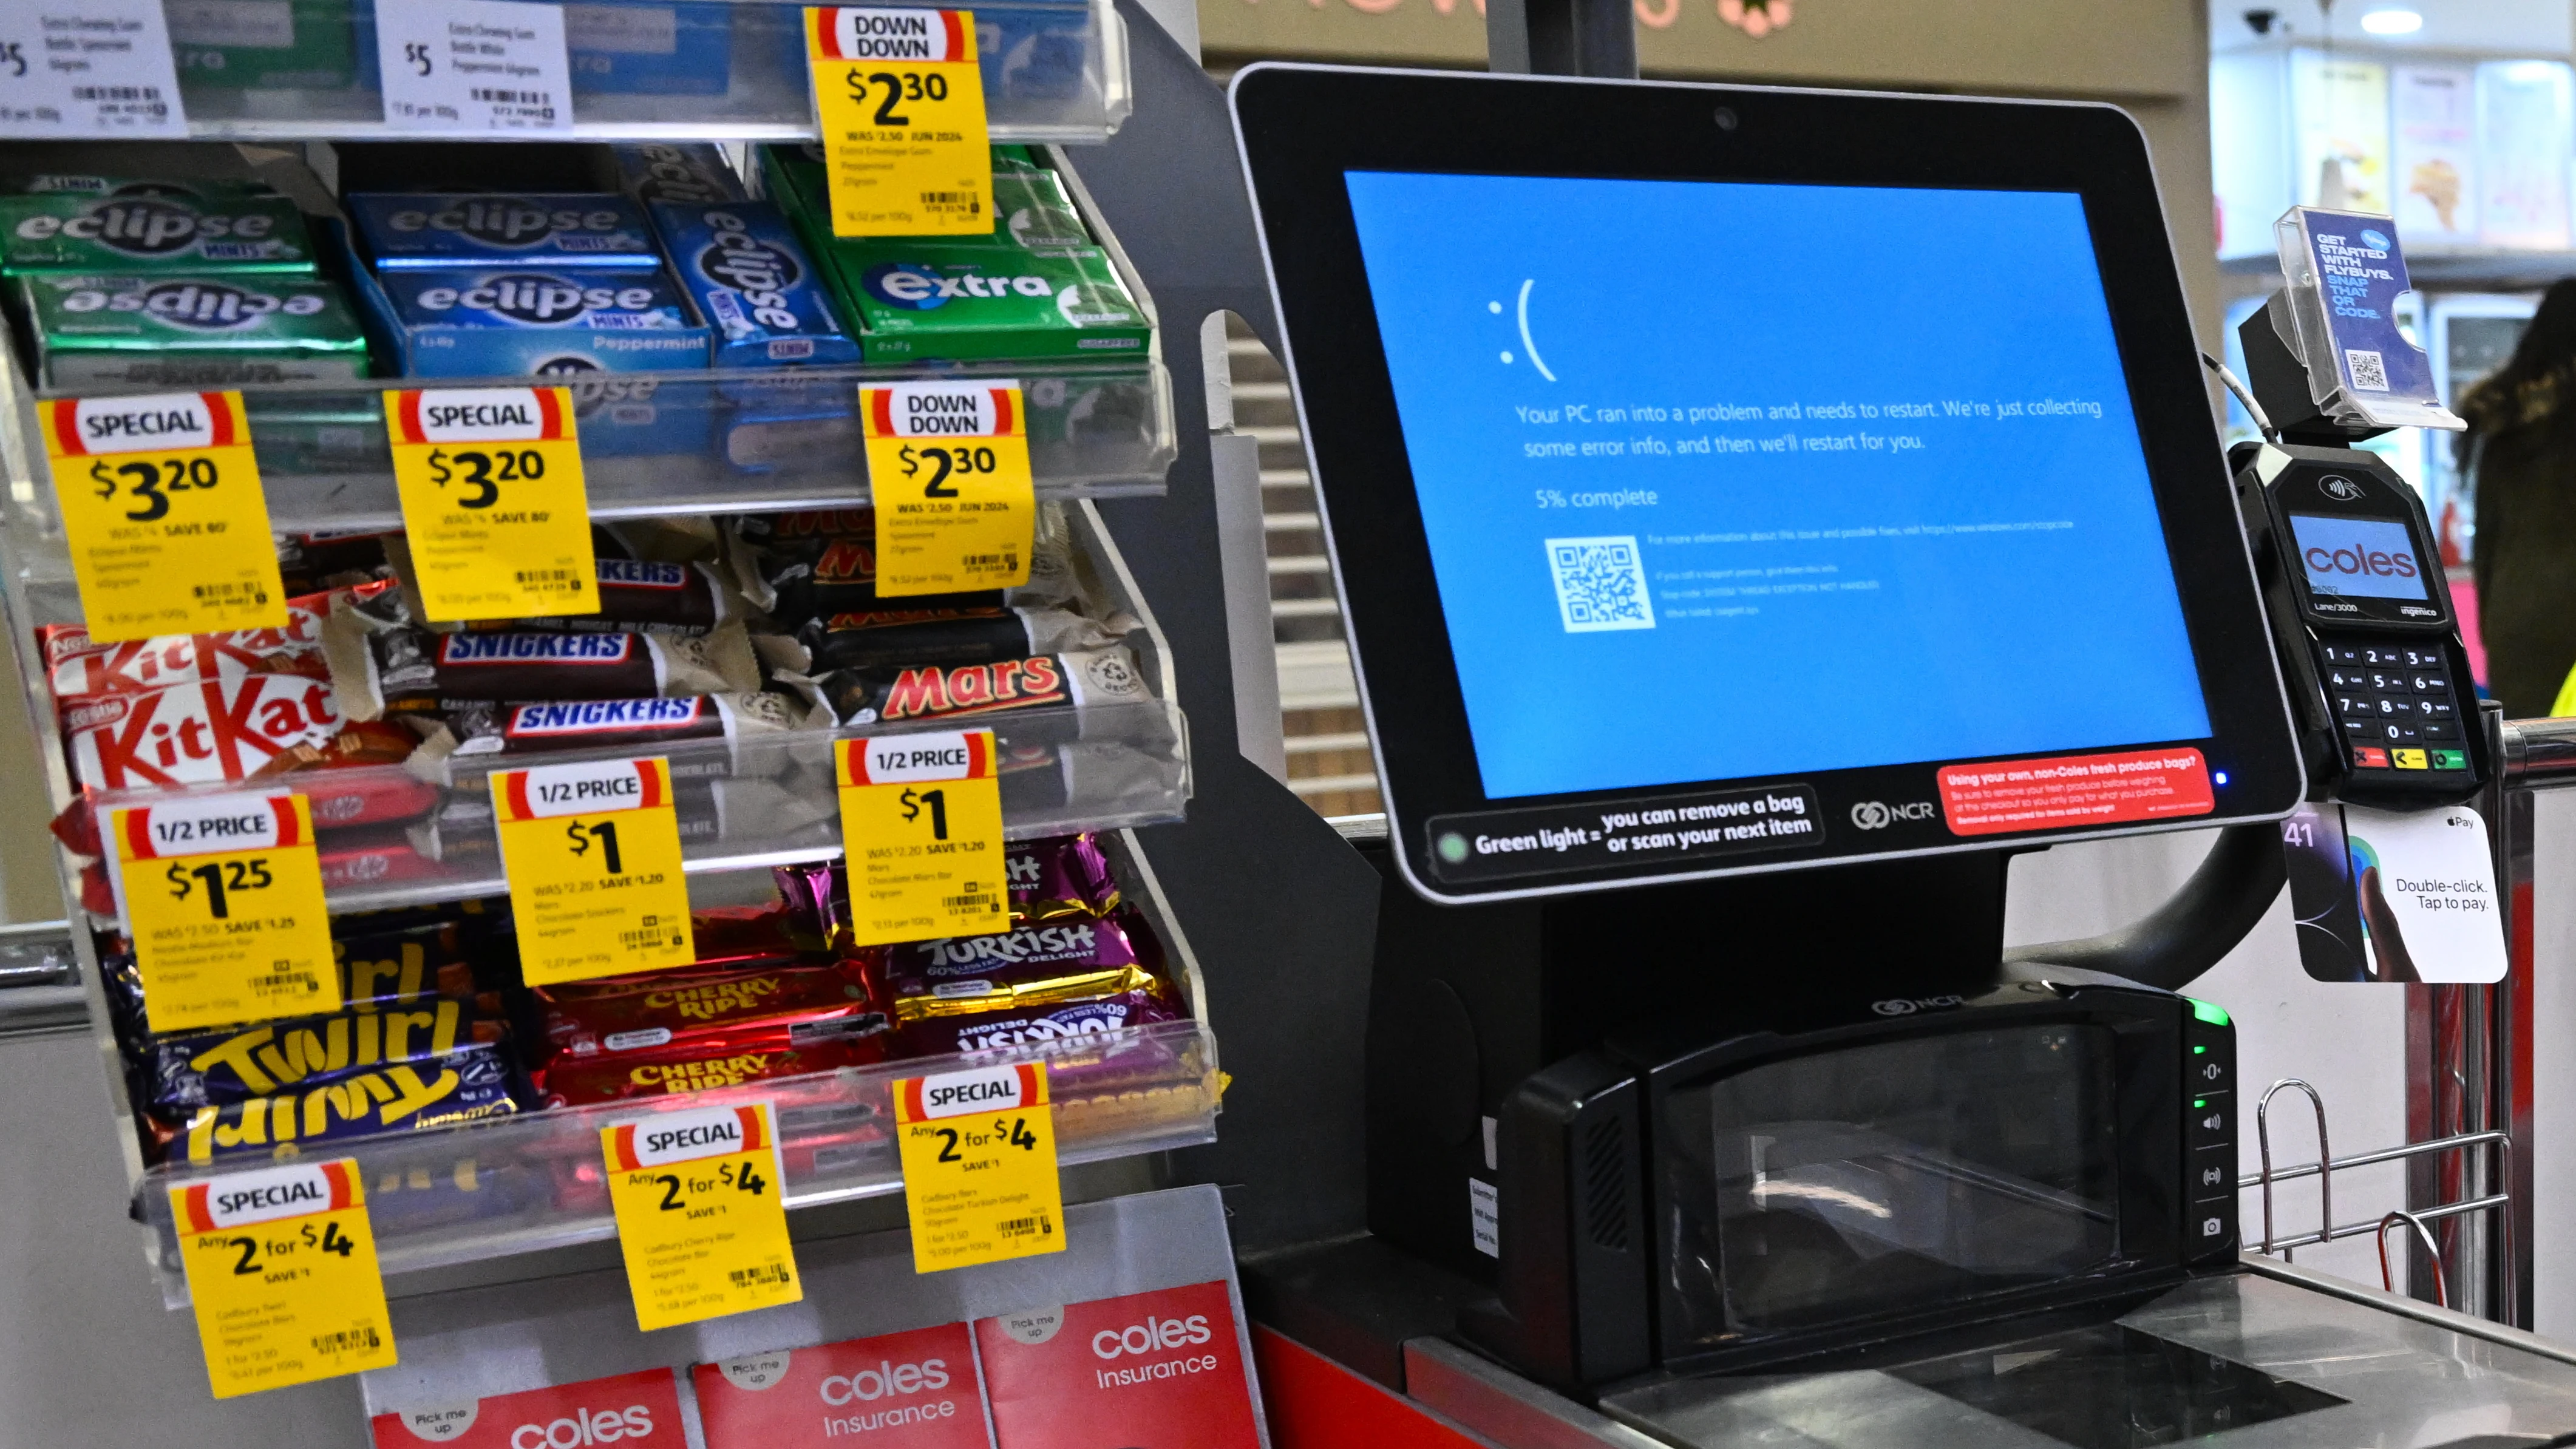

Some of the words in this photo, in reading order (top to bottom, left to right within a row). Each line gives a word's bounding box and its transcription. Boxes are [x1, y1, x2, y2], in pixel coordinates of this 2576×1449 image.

[854, 16, 927, 35] DOWN
[857, 38, 929, 58] DOWN
[405, 42, 432, 76] $5
[16, 208, 274, 248] eclipse
[389, 199, 620, 240] eclipse
[2317, 233, 2347, 245] GET
[2319, 244, 2388, 260] STARTED
[2323, 255, 2362, 267] WITH
[2325, 264, 2394, 280] FLYBUYS.
[2327, 275, 2369, 288] SNAP
[880, 271, 1053, 301] extra
[2330, 285, 2369, 299] THAT
[417, 280, 654, 319] eclipse
[2333, 295, 2356, 307] OR
[2334, 306, 2381, 319] CODE.
[593, 335, 705, 352] Peppermint
[908, 395, 977, 413] DOWN
[1515, 406, 1559, 424] Your
[1565, 404, 1592, 423] PC
[1597, 406, 1628, 422] ran
[1631, 405, 1667, 422] into
[1673, 407, 1684, 422] a
[1689, 403, 1763, 425] problem
[1768, 402, 1801, 420] and
[1806, 401, 1857, 419] needs
[1860, 402, 1879, 418] to
[1883, 401, 1939, 418] restart.
[1942, 399, 1991, 417] We're
[1996, 399, 2023, 421] just
[2027, 398, 2102, 418] collecting
[86, 407, 203, 439] SPECIAL
[427, 404, 534, 427] SPECIAL
[909, 415, 980, 434] DOWN
[1524, 441, 1577, 458] some
[1582, 441, 1625, 457] error
[1630, 435, 1672, 458] info,
[1676, 435, 1711, 454] and
[1715, 435, 1756, 453] then
[1759, 434, 1798, 452] we'll
[1803, 433, 1857, 452] restart
[1860, 432, 1885, 450] for
[1888, 435, 1926, 453] you.
[1535, 489, 1568, 509] 5%
[1571, 488, 1659, 511] complete
[492, 512, 527, 525] SAVE
[165, 523, 202, 537] SAVE
[2305, 543, 2416, 578] coles
[2314, 603, 2358, 613] Lane/3000
[2400, 606, 2438, 617] ingenico
[451, 631, 625, 659] SNICKERS
[2326, 647, 2335, 660] 1
[2366, 650, 2378, 663] 2
[2407, 652, 2419, 665] 3
[882, 656, 1060, 721] Mars
[2333, 673, 2343, 685] 4
[2374, 675, 2385, 688] 5
[2415, 677, 2426, 689] 6
[520, 697, 693, 728] SNICKERS
[2340, 698, 2350, 712] 7
[2381, 700, 2393, 713] 8
[2421, 701, 2432, 714] 9
[93, 675, 339, 791] KitKat
[2387, 725, 2399, 739] 0
[877, 752, 906, 771] 1/2
[911, 747, 968, 768] PRICE
[1948, 773, 1980, 787] Using
[1980, 773, 2006, 786] your
[2007, 770, 2034, 782] own,
[2034, 765, 2090, 780] non-Coles
[2090, 762, 2118, 776] fresh
[2119, 759, 2163, 774] produce
[2164, 755, 2197, 770] bags?
[538, 782, 573, 804] 1/2
[576, 776, 640, 799] PRICE
[900, 787, 948, 840] $1
[1602, 810, 1639, 835] you
[1642, 808, 1675, 827] can
[1679, 801, 1750, 823] remove
[1752, 801, 1766, 816] a
[1768, 793, 1804, 816] bag
[1892, 801, 1935, 821] NCR
[155, 821, 192, 843] 1/2
[199, 811, 270, 840] PRICE
[2455, 816, 2474, 830] Pay
[1475, 833, 1538, 855] Green
[1540, 827, 1587, 852] light
[1607, 835, 1628, 852] or
[1631, 830, 1676, 850] scan
[1677, 829, 1720, 850] your
[1724, 823, 1767, 842] next
[1768, 818, 1812, 838] item
[2284, 822, 2314, 848] 41
[567, 820, 623, 874] $1
[926, 842, 957, 855] SAVE
[599, 875, 633, 889] SAVE
[2396, 878, 2488, 894] Double-click.
[2416, 895, 2442, 911] Tap
[2445, 896, 2459, 909] to
[2462, 897, 2490, 911] pay.
[225, 918, 262, 934] SAVE
[917, 924, 1096, 966] TURKISH
[1027, 950, 1096, 964] DELIGHT
[644, 977, 780, 1010] CHERRY
[1916, 993, 1965, 1010] NCR
[678, 994, 759, 1020] RIPE
[191, 1000, 460, 1095] Twirl
[629, 1054, 769, 1087] CHERRY
[929, 1079, 1017, 1107] SPECIAL
[646, 1121, 741, 1153] SPECIAL
[911, 1124, 938, 1140] Any
[936, 1127, 962, 1164] 2
[964, 1130, 991, 1149] for
[994, 1117, 1038, 1152] $4
[962, 1160, 990, 1172] SAVE
[628, 1172, 656, 1187] Any
[656, 1174, 685, 1212] 2
[688, 1176, 716, 1194] for
[718, 1161, 766, 1196] $4
[217, 1180, 325, 1214] SPECIAL
[686, 1206, 716, 1220] SAVE
[197, 1235, 229, 1251] Any
[229, 1236, 264, 1277] 2
[265, 1238, 297, 1258] for
[300, 1221, 355, 1258] $4
[264, 1269, 297, 1285] SAVE
[1010, 1316, 1038, 1331] Pick
[1038, 1314, 1056, 1325] me
[1027, 1326, 1042, 1339] up
[1092, 1313, 1211, 1360] coles
[732, 1362, 759, 1376] Pick
[761, 1359, 780, 1372] me
[1096, 1351, 1218, 1390] Insurance
[750, 1373, 767, 1385] up
[818, 1357, 950, 1408] coles
[415, 1410, 444, 1425] Pick
[446, 1408, 467, 1420] me
[510, 1403, 654, 1449] coles
[823, 1399, 956, 1439] Insurance
[434, 1424, 452, 1435] up
